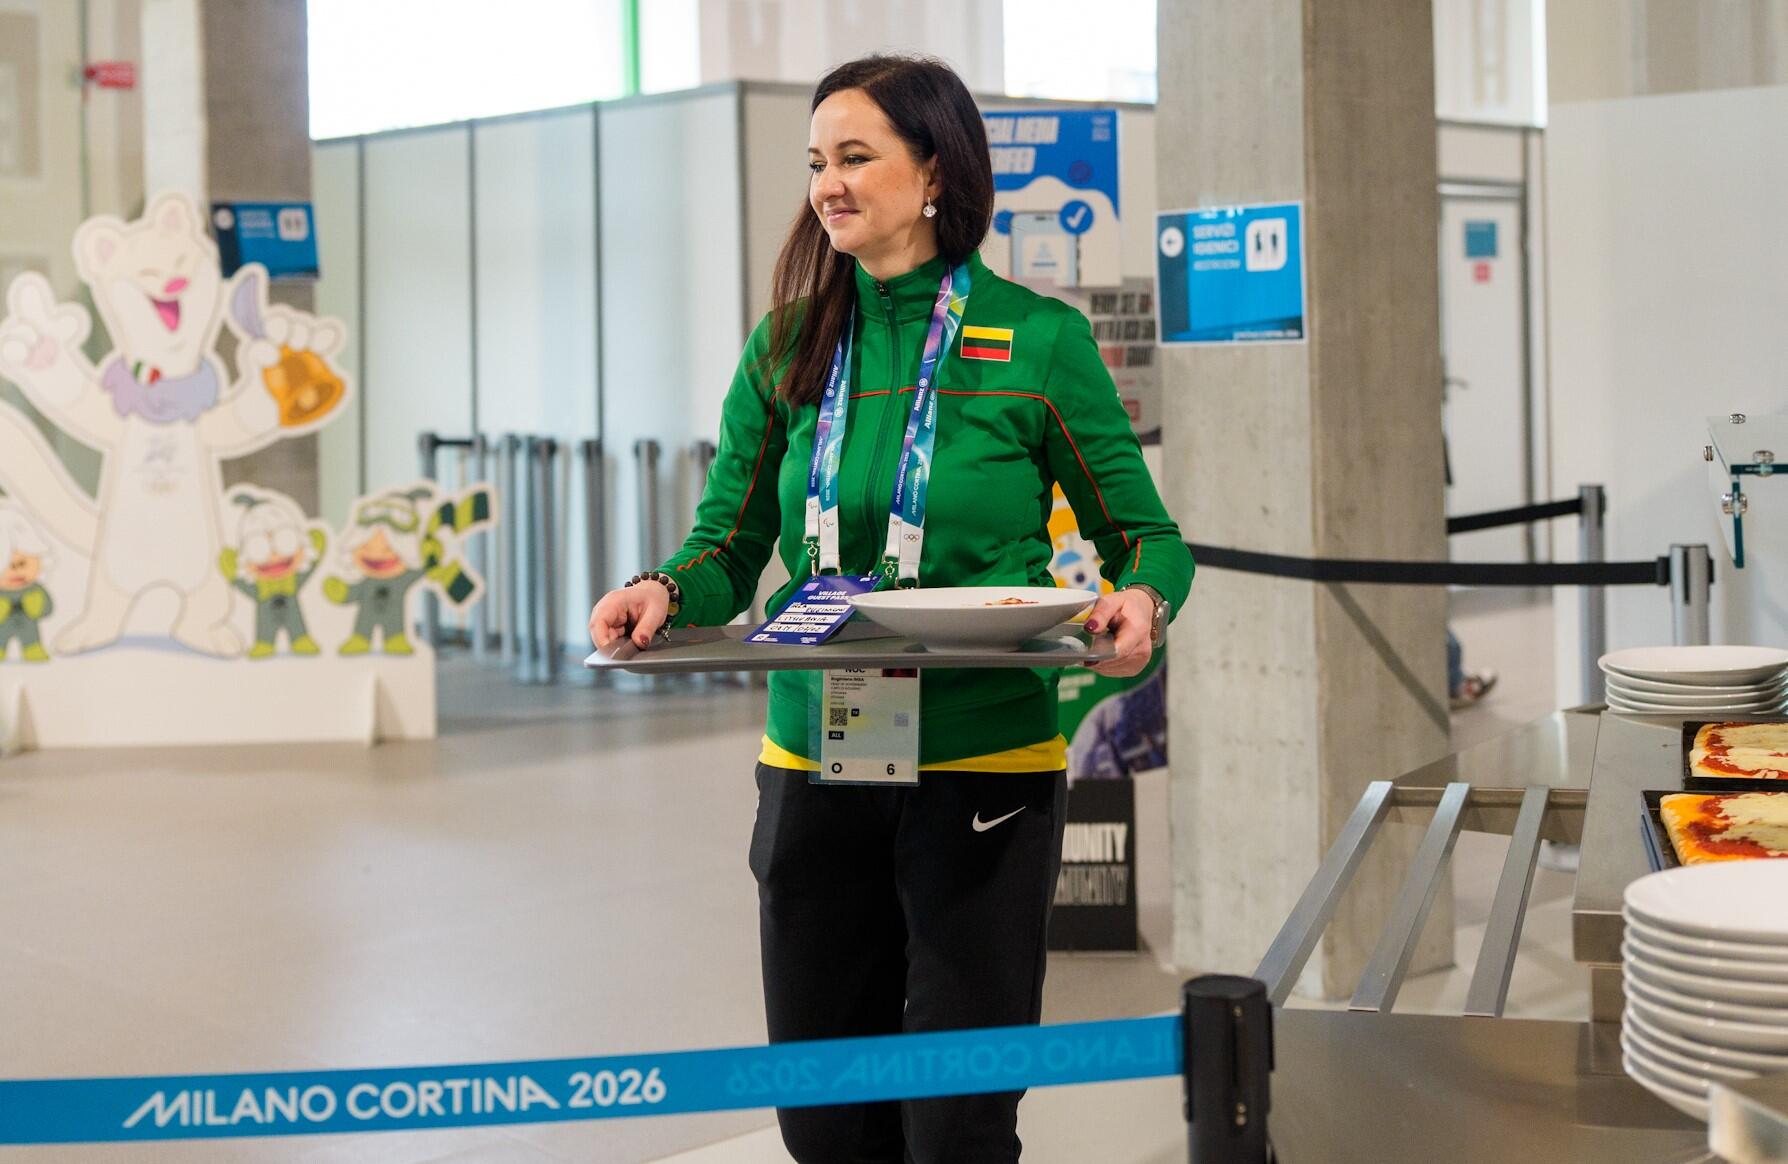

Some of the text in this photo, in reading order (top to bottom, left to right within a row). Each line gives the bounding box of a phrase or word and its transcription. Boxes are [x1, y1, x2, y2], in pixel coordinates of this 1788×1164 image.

[829, 364, 839, 388] Allianz
[837, 379, 847, 406] Allianz
[913, 387, 925, 412] Allianz
[924, 401, 934, 429] Allianz
[886, 763, 896, 776] 6
[122, 1066, 667, 1129] MILANO CORTINA 2026
